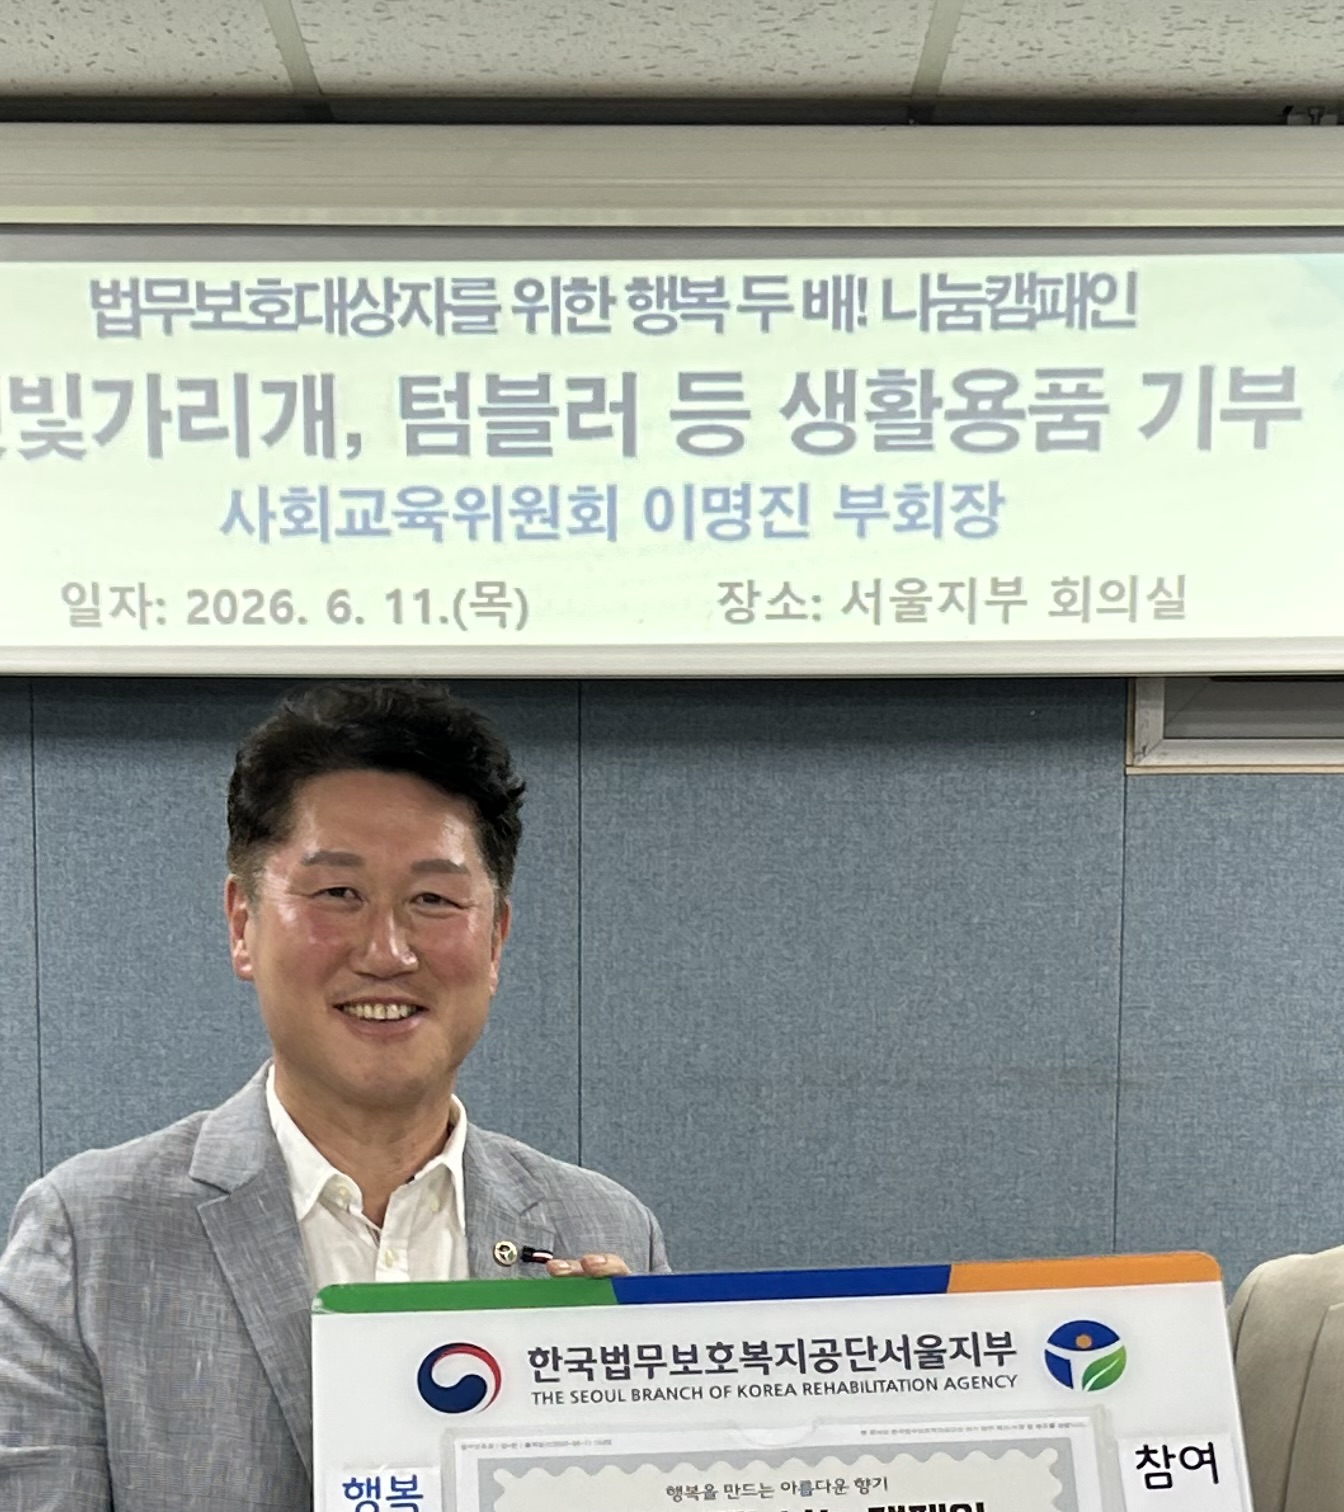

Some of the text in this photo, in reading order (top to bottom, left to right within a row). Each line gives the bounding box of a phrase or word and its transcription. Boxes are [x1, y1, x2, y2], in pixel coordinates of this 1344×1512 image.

[89, 270, 1138, 340] 법무보호대상자를 위한 행복 두 배! 나눔캠패인
[398, 371, 638, 459] 텀블러
[669, 371, 752, 457] 등
[778, 367, 1110, 457] 생활용품
[1138, 364, 1303, 452] 기부
[219, 480, 1006, 545] 사회교육위원회 이명진 부회장
[61, 580, 529, 632] 일자: 2026. 6. 11.(목)
[717, 574, 1186, 626] 장소: 서울지부 회의실
[527, 1331, 1018, 1383] 한국법무보호복지공단서울지부
[531, 1374, 1019, 1406] THE SEOUL BRANCH OF KOREA REHABILITATION AGENCY
[665, 1475, 889, 1503] 행복을 만드는 아름다운 향기
[1135, 1441, 1219, 1490] 참여
